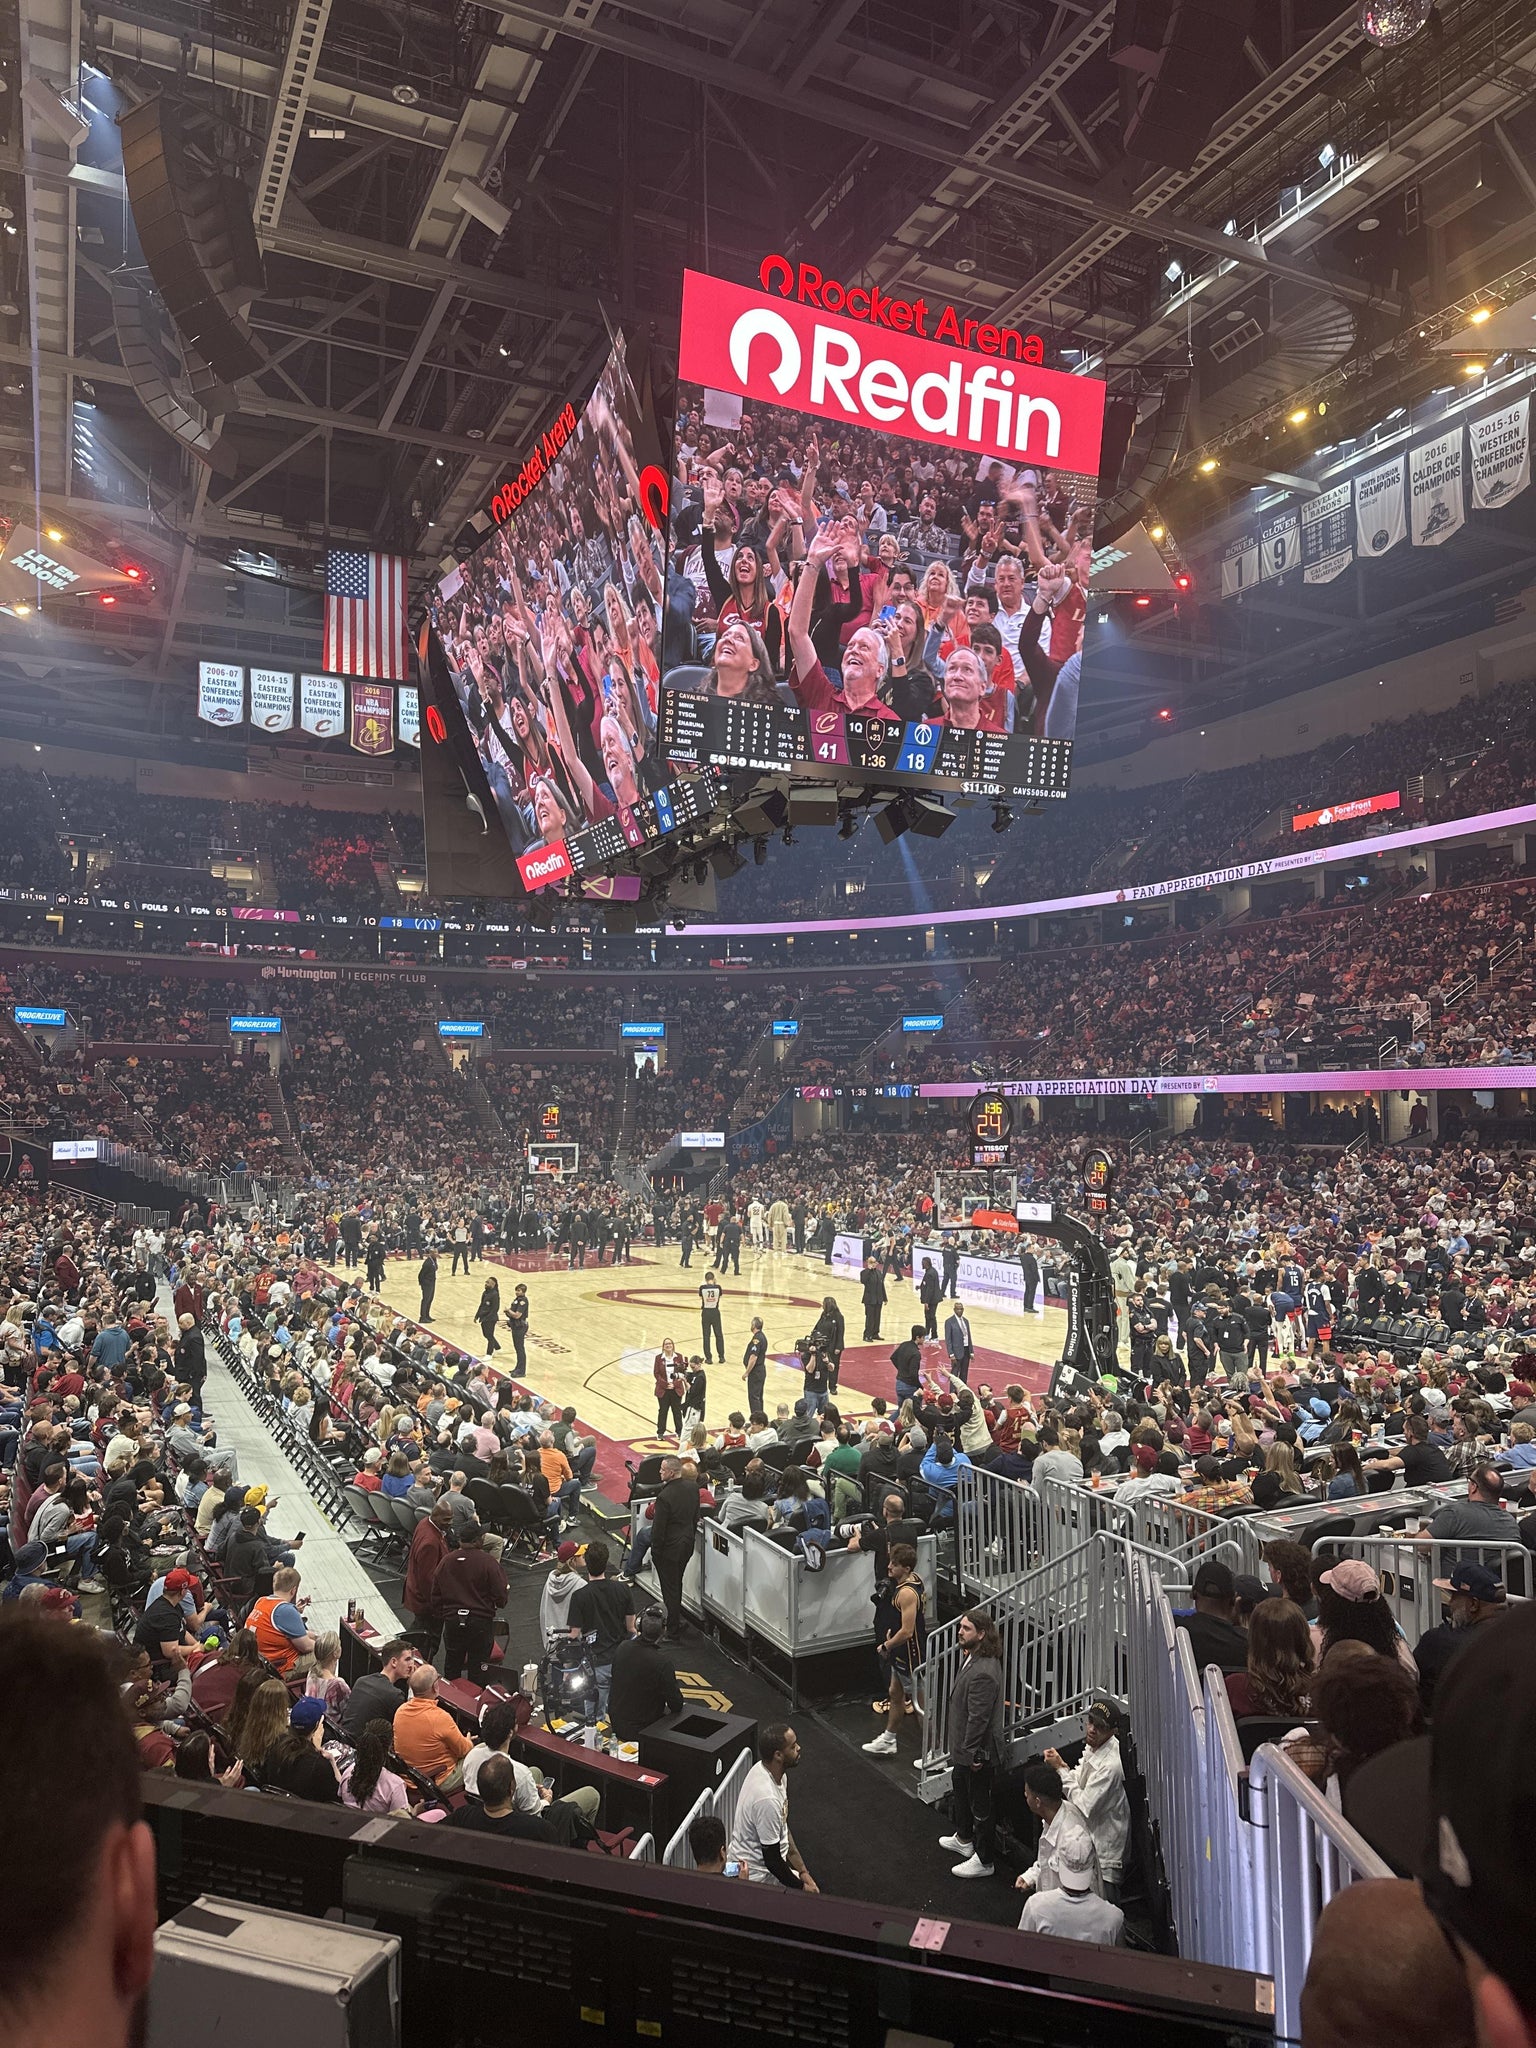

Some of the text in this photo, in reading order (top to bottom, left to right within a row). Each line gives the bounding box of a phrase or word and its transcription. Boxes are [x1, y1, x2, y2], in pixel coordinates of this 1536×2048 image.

[798, 261, 1044, 364] Rocket Arena
[810, 323, 1062, 459] Redfin
[1479, 411, 1520, 438] 2015-16
[1480, 427, 1519, 453] WESTERN
[502, 402, 576, 509] Rocket Arena
[1425, 443, 1447, 462] 2016
[1474, 438, 1526, 468] CONFERENCE
[1413, 452, 1461, 483] CALDER CUP
[1476, 452, 1524, 481] CHAMPIONS
[1361, 466, 1399, 489] NORTH DIVISION
[1414, 466, 1460, 496] CHAMPIONS
[1360, 474, 1400, 500] CHAMPIONS
[1303, 486, 1348, 513] CLEVELAND
[1310, 498, 1341, 518] BARONS
[1263, 517, 1296, 538] GLOVER
[1226, 538, 1253, 557] BOWER
[1274, 538, 1286, 569] 9
[23, 549, 81, 582] LET EM
[1235, 556, 1242, 587] 1
[1311, 562, 1345, 581] CHAMPIONS
[10, 556, 69, 590] KNOW.
[207, 667, 238, 677] 2006-07
[258, 674, 288, 684] 2014-15
[208, 678, 236, 687] EASTERN
[259, 685, 286, 693] EASTERN
[308, 679, 337, 689] 2015-16
[202, 686, 242, 697] CONFERENCE
[254, 692, 292, 703] CONFERENCE
[309, 690, 336, 698] EASTERN
[679, 693, 708, 701] CAVALIERS
[204, 695, 240, 705] CHAMPIONS
[255, 701, 290, 711] CHAMPIONS
[304, 699, 342, 708] CONFERENCE
[366, 698, 379, 706] NBA
[305, 707, 340, 716] CHAMPIONS
[355, 705, 390, 715] CHAMPIONS
[677, 729, 703, 737] PROCTOR
[850, 723, 862, 733] 1Q
[888, 727, 899, 737] 24
[669, 749, 697, 758] oswald
[819, 743, 837, 759] 41
[750, 759, 791, 771] RAFFLE
[861, 754, 886, 767] 1:36
[907, 753, 925, 770] 18
[963, 782, 1066, 798] $11,104 CAVS5050.COM
[1334, 800, 1371, 814] ForeFront
[662, 814, 671, 827] 18
[630, 829, 638, 842] 41
[645, 825, 657, 838] 1:36
[534, 854, 565, 877] Redfin
[1133, 856, 1311, 898] FAN APPRECIATION DAY PRESENTED BY
[174, 905, 180, 914] 4
[191, 907, 210, 915] FG%
[216, 908, 226, 916] 65
[274, 912, 284, 920] 41
[392, 919, 402, 927] 18
[277, 967, 336, 981] Huntington
[19, 1012, 61, 1021] PROGRESSIVE
[905, 1018, 941, 1029] PROGRESSIVE
[233, 1020, 278, 1029] PROGRESSIVE
[441, 1025, 479, 1033] PROGRESSIVE
[623, 1025, 661, 1033] PROGRESSIVE
[1012, 1084, 1032, 1095] FAN
[1037, 1081, 1126, 1094] APPRECIATION
[1132, 1080, 1157, 1092] DAY
[985, 1103, 1002, 1114] 1:36
[543, 1114, 557, 1125] 24
[977, 1115, 1000, 1135] 24
[1091, 1172, 1103, 1185] 24
[1290, 1276, 1298, 1286] 15
[1312, 1295, 1317, 1305] 7
[1068, 1332, 1077, 1357] Clinic
